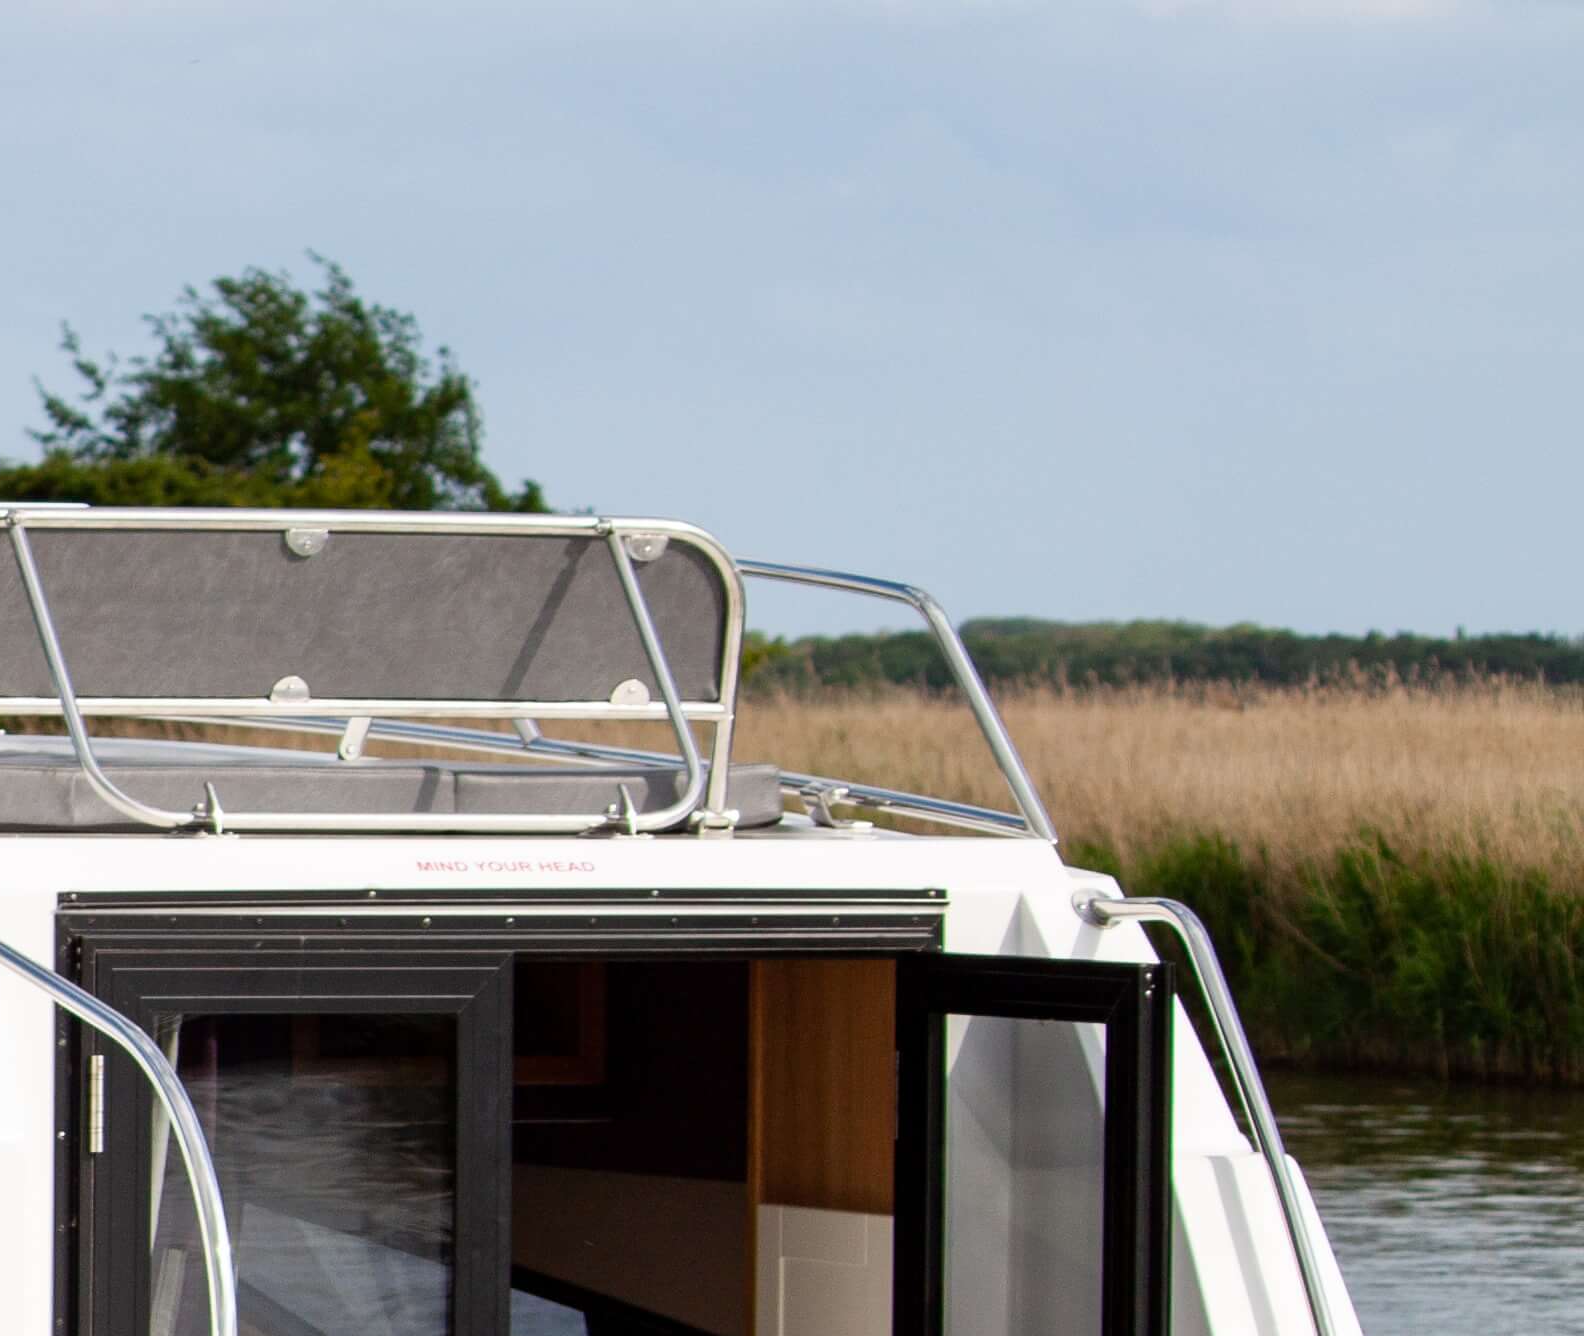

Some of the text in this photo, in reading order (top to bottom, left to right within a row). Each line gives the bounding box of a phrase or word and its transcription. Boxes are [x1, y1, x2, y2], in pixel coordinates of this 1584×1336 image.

[416, 861, 596, 872] MIND YOUR HEAD
